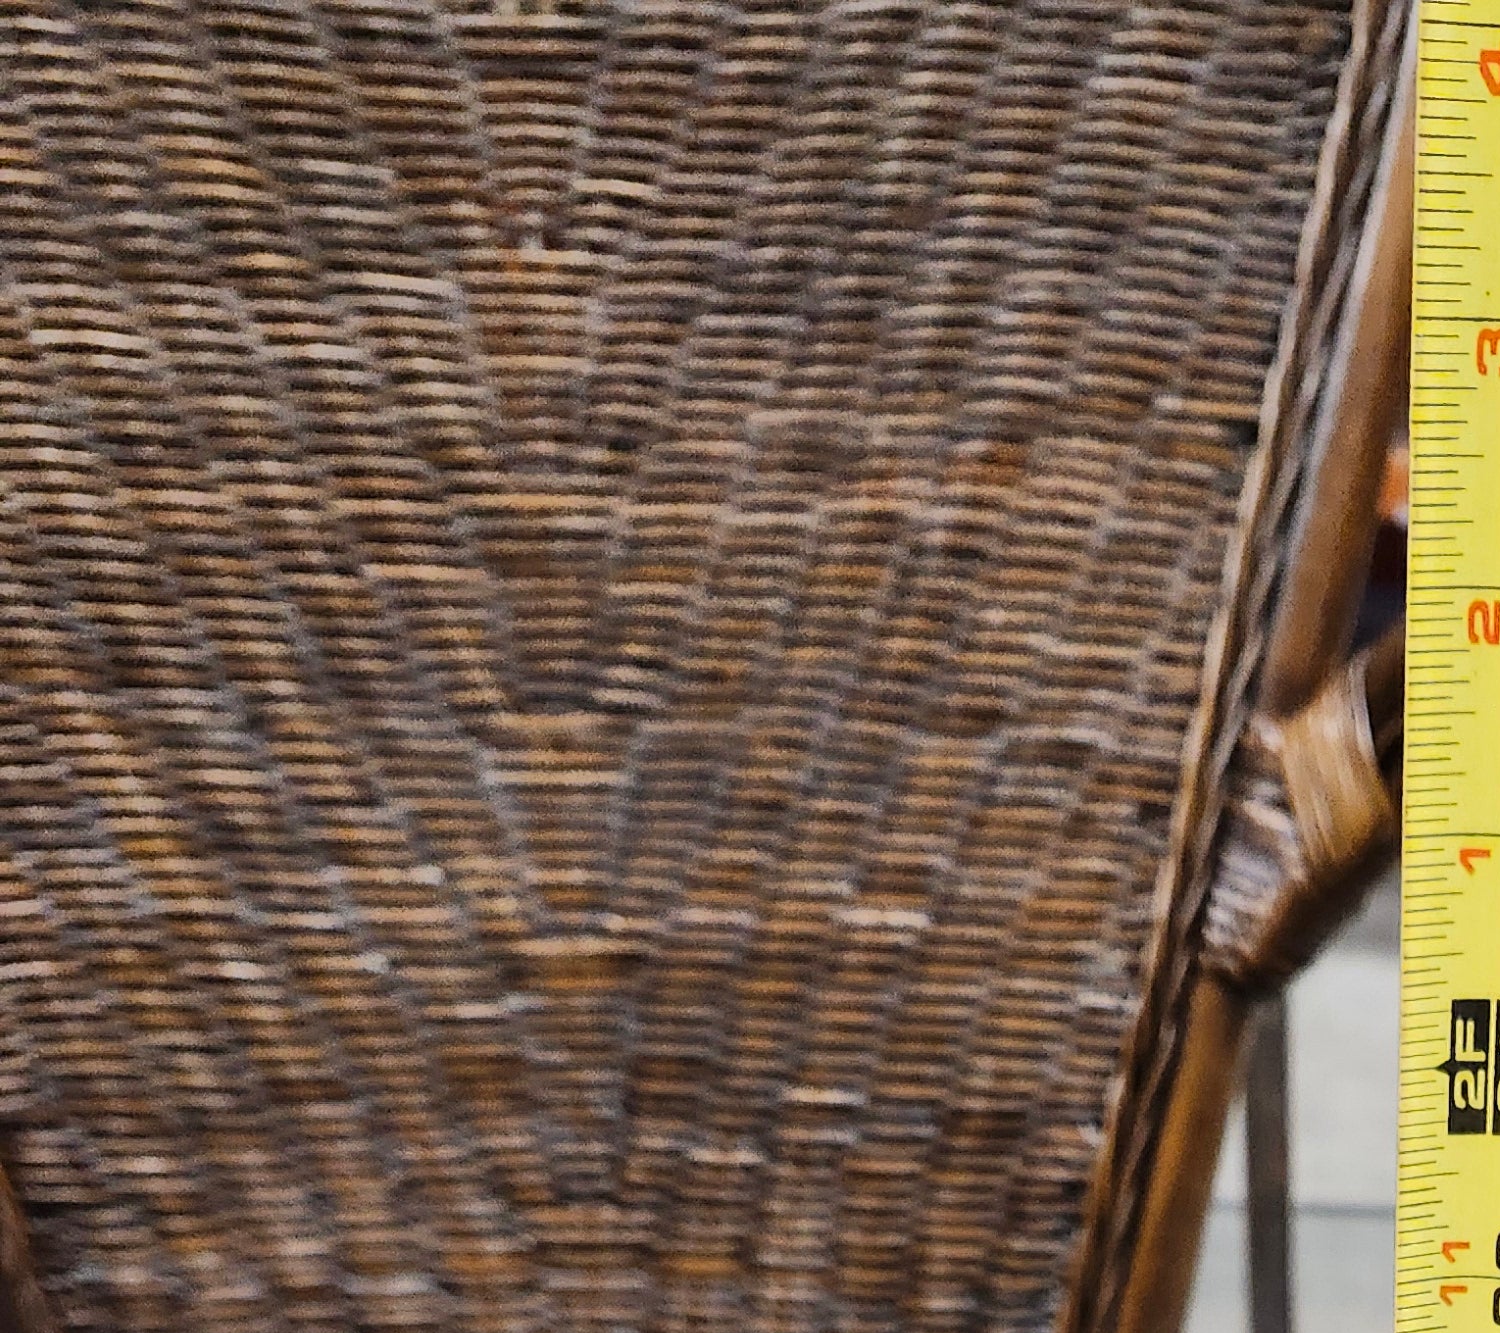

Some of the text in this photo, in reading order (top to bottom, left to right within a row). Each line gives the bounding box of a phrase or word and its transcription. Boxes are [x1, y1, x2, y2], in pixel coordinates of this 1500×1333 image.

[1459, 847, 1492, 875] 1
[1453, 1016, 1487, 1111] 2F
[1439, 1240, 1471, 1307] 11
